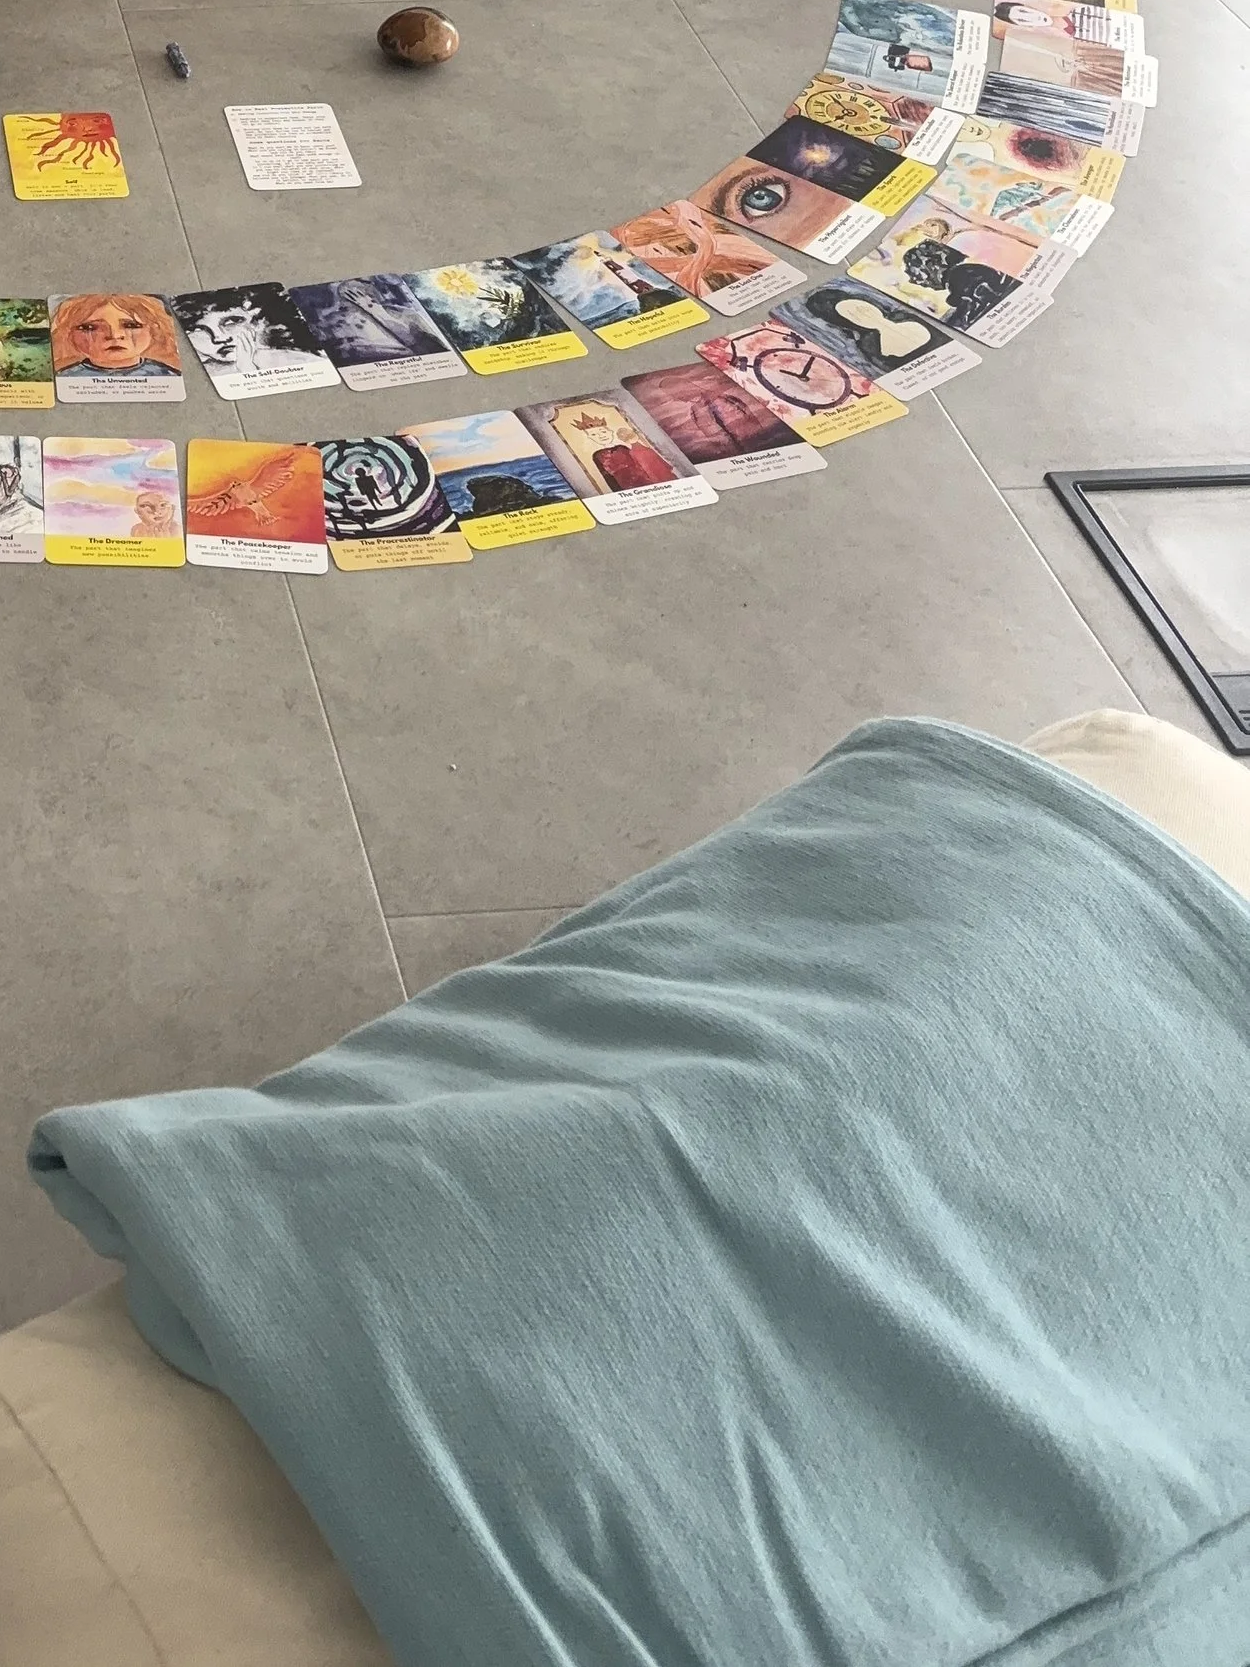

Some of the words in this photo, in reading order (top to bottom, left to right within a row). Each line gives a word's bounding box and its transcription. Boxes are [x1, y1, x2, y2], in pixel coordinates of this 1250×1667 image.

[739, 277, 752, 286] Lost
[627, 318, 642, 326] The
[641, 311, 665, 324] Hopeful
[512, 339, 542, 348] Survivor
[388, 356, 423, 365] Regretful
[900, 364, 913, 373] The
[910, 354, 938, 368] Defective
[836, 403, 856, 413] Alarm
[744, 451, 781, 463] Wounded
[632, 484, 673, 495] Grandiose
[519, 508, 539, 516] Rock
[221, 538, 237, 546] The
[238, 539, 292, 551] Peacekeeper
[376, 535, 436, 545] Procrastinator
